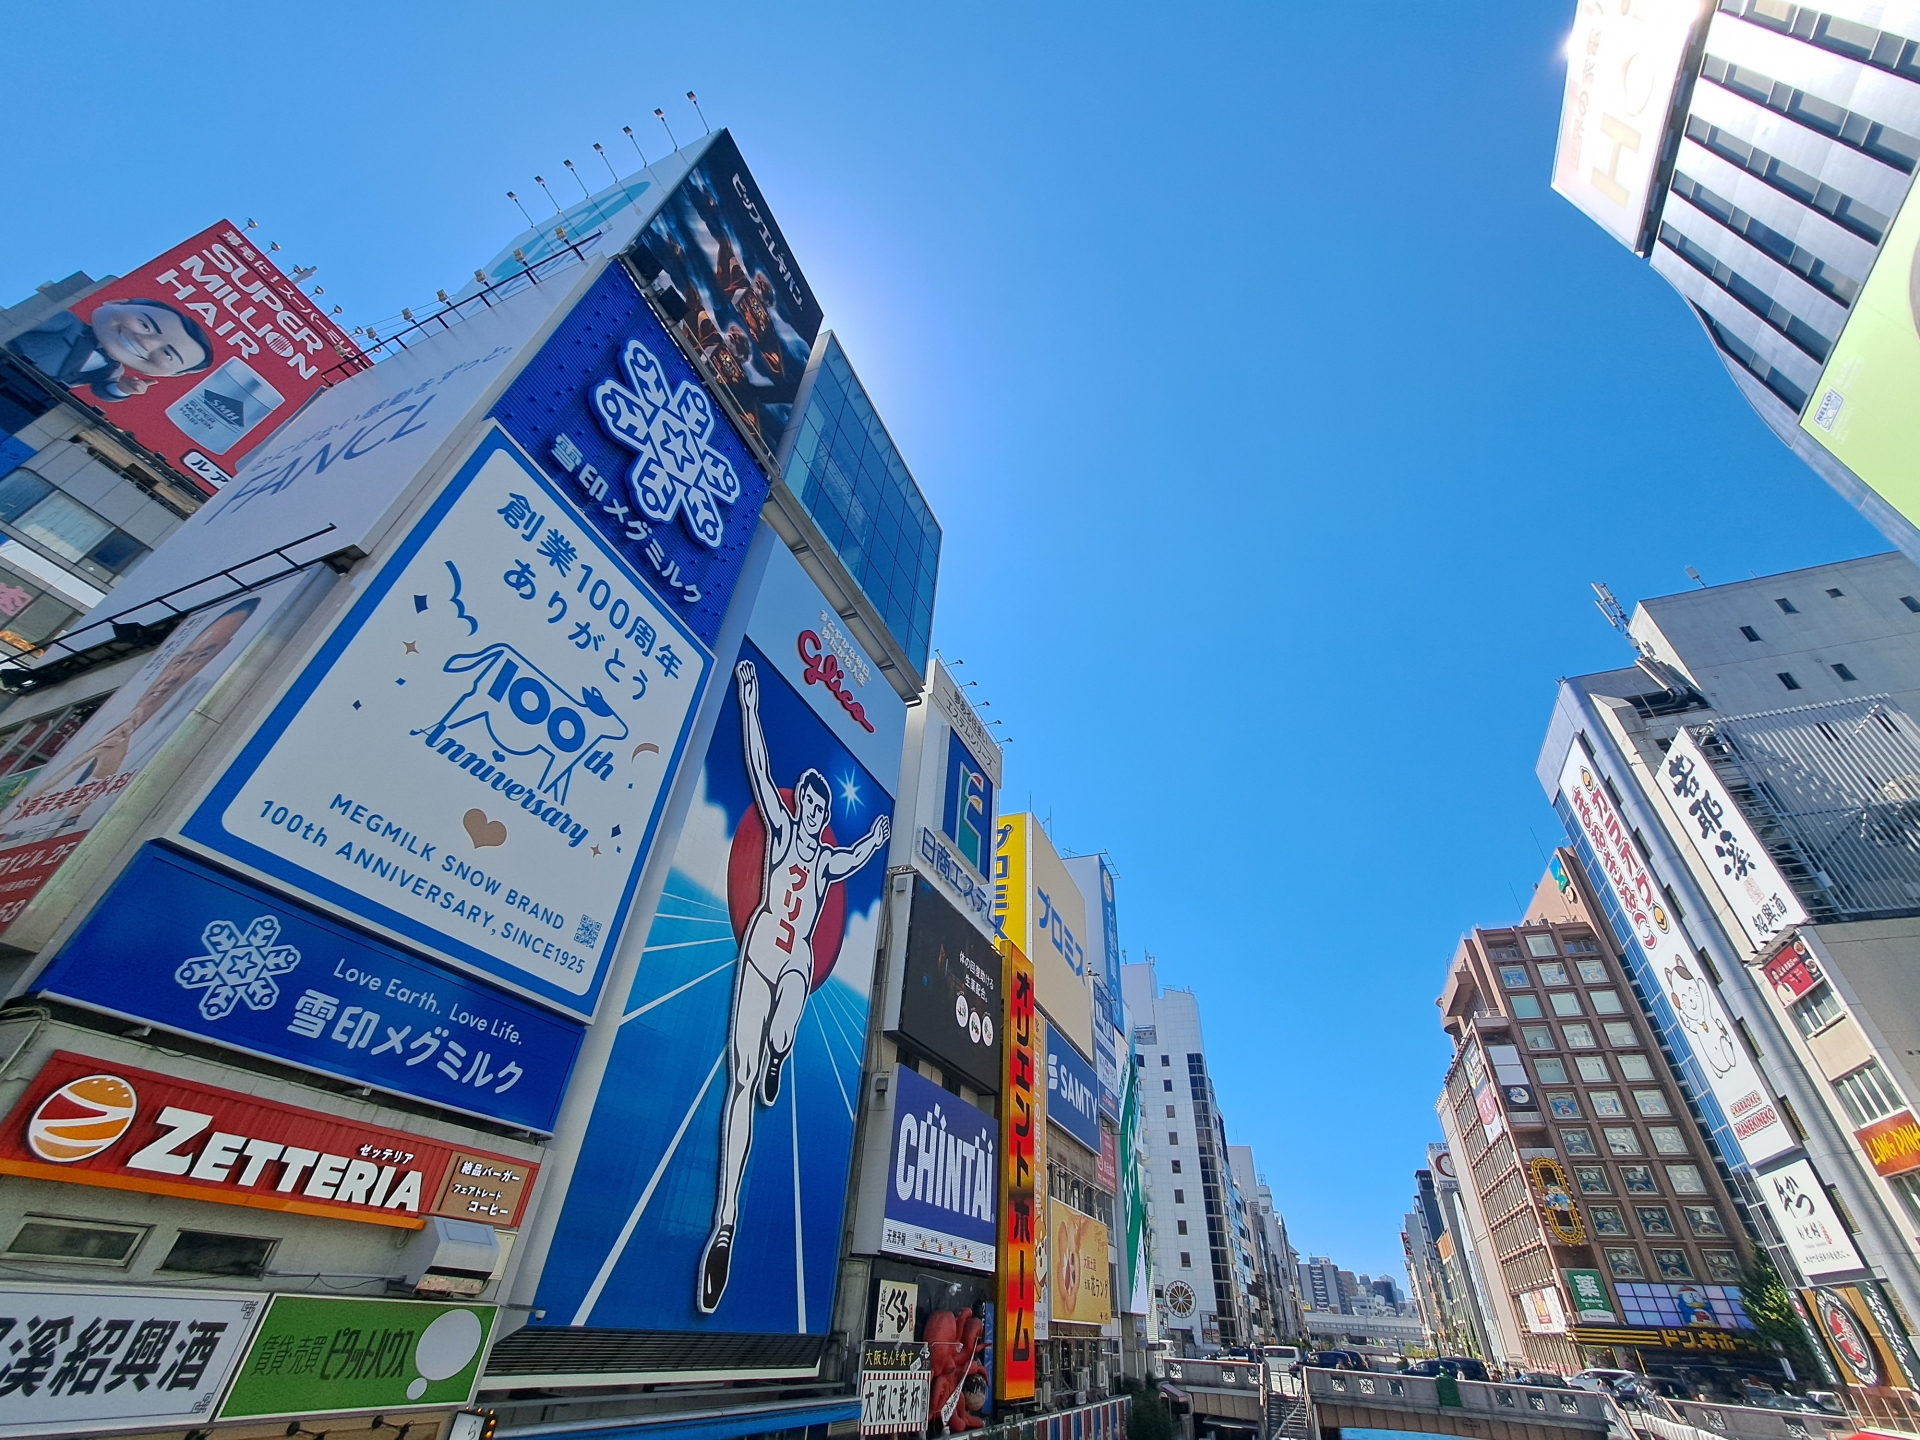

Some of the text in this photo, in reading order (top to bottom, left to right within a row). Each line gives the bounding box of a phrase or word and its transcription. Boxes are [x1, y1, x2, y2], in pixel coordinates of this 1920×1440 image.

[156, 269, 260, 360] HAIR
[179, 255, 319, 381] MILLION
[202, 243, 324, 355] SUPER
[209, 393, 437, 521] FANCL
[213, 400, 240, 420] SMH
[551, 432, 702, 604] 雪印メグミルク
[497, 492, 683, 680] 創業100周年
[503, 559, 648, 700] ありがとう
[798, 629, 875, 733] Glico
[410, 723, 589, 848] Anniversary
[42, 842, 78, 866] 2F
[259, 800, 586, 975] 100th ANNIVERSARY, SINCE1925
[329, 793, 565, 930] MEGMILK SNOW BRAND
[1572, 787, 1657, 950] まねきねこ
[1589, 787, 1655, 907] カラオケ
[775, 862, 810, 955] グリコ
[1037, 886, 1086, 987] プロミス
[287, 988, 524, 1094] 雪印メグミルク
[333, 957, 523, 1046] Love Earth. Love Life.
[1060, 1064, 1098, 1126] SAMTY
[1732, 1090, 1761, 1115] KARAOKE
[1734, 1105, 1777, 1140] MANEKINEKO
[125, 1106, 423, 1213] ZETTERIA
[360, 1144, 414, 1165] ゼッテリア
[453, 1184, 503, 1201] フェアトレード
[460, 1160, 521, 1183] 絶品バーガー
[896, 1103, 995, 1223] CHINTAI
[1865, 1132, 1900, 1166] LONG
[467, 1200, 510, 1217] コーヒー
[1573, 1275, 1600, 1298] 薬
[320, 1326, 415, 1381] ピタットハウス
[863, 1381, 921, 1423] 大阪に乾杯
